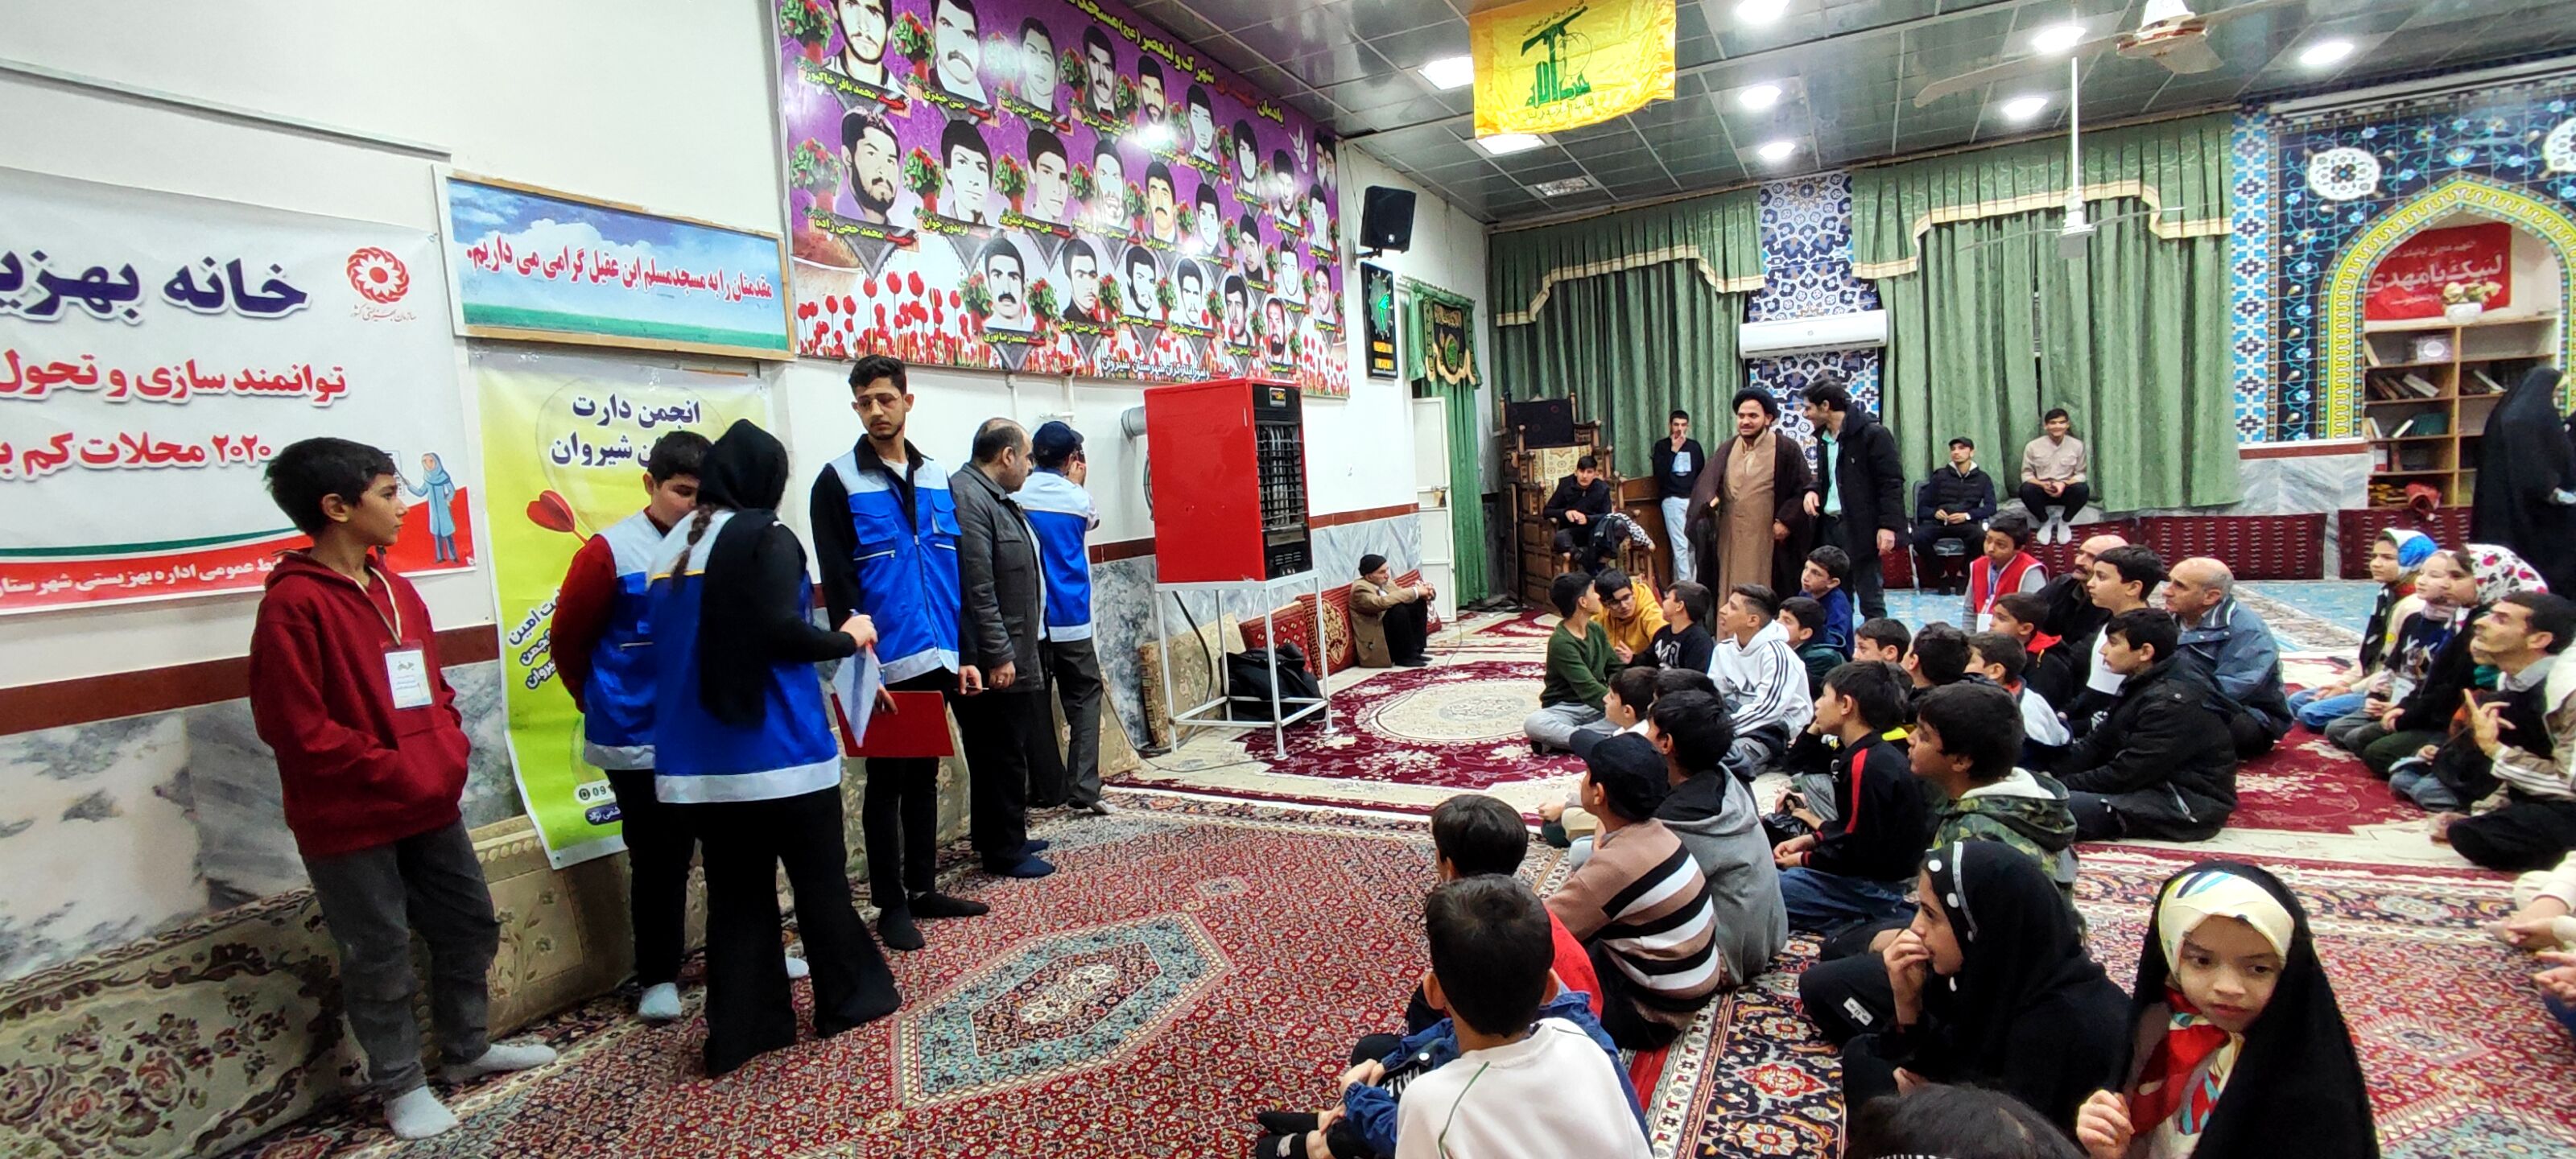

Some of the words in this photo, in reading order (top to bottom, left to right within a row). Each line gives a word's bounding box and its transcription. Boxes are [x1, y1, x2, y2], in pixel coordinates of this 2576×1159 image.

[860, 228, 884, 239] محمد
[517, 251, 539, 275] می
[543, 245, 584, 282] گرامی
[589, 250, 619, 283] عقیل
[622, 256, 641, 288] ابن
[644, 258, 672, 291] مسلم
[163, 256, 309, 314] خانه
[671, 268, 706, 295] مسجد
[708, 272, 720, 298] به
[720, 268, 730, 301] را
[733, 272, 772, 301] مقدمتان
[0, 349, 98, 394] تحول
[108, 369, 127, 398] و
[136, 358, 225, 399] سازی
[233, 363, 346, 402] توانمند
[572, 393, 632, 427] دارت
[638, 400, 701, 430] انجمن
[24, 431, 73, 476] کم
[80, 431, 205, 464] محلات
[551, 431, 633, 467] شیروان
[0, 572, 73, 597] شهرستا
[75, 570, 153, 592] بهزیستی
[155, 563, 197, 586] اداره
[199, 562, 254, 581] عمومی
[509, 609, 541, 645] امین
